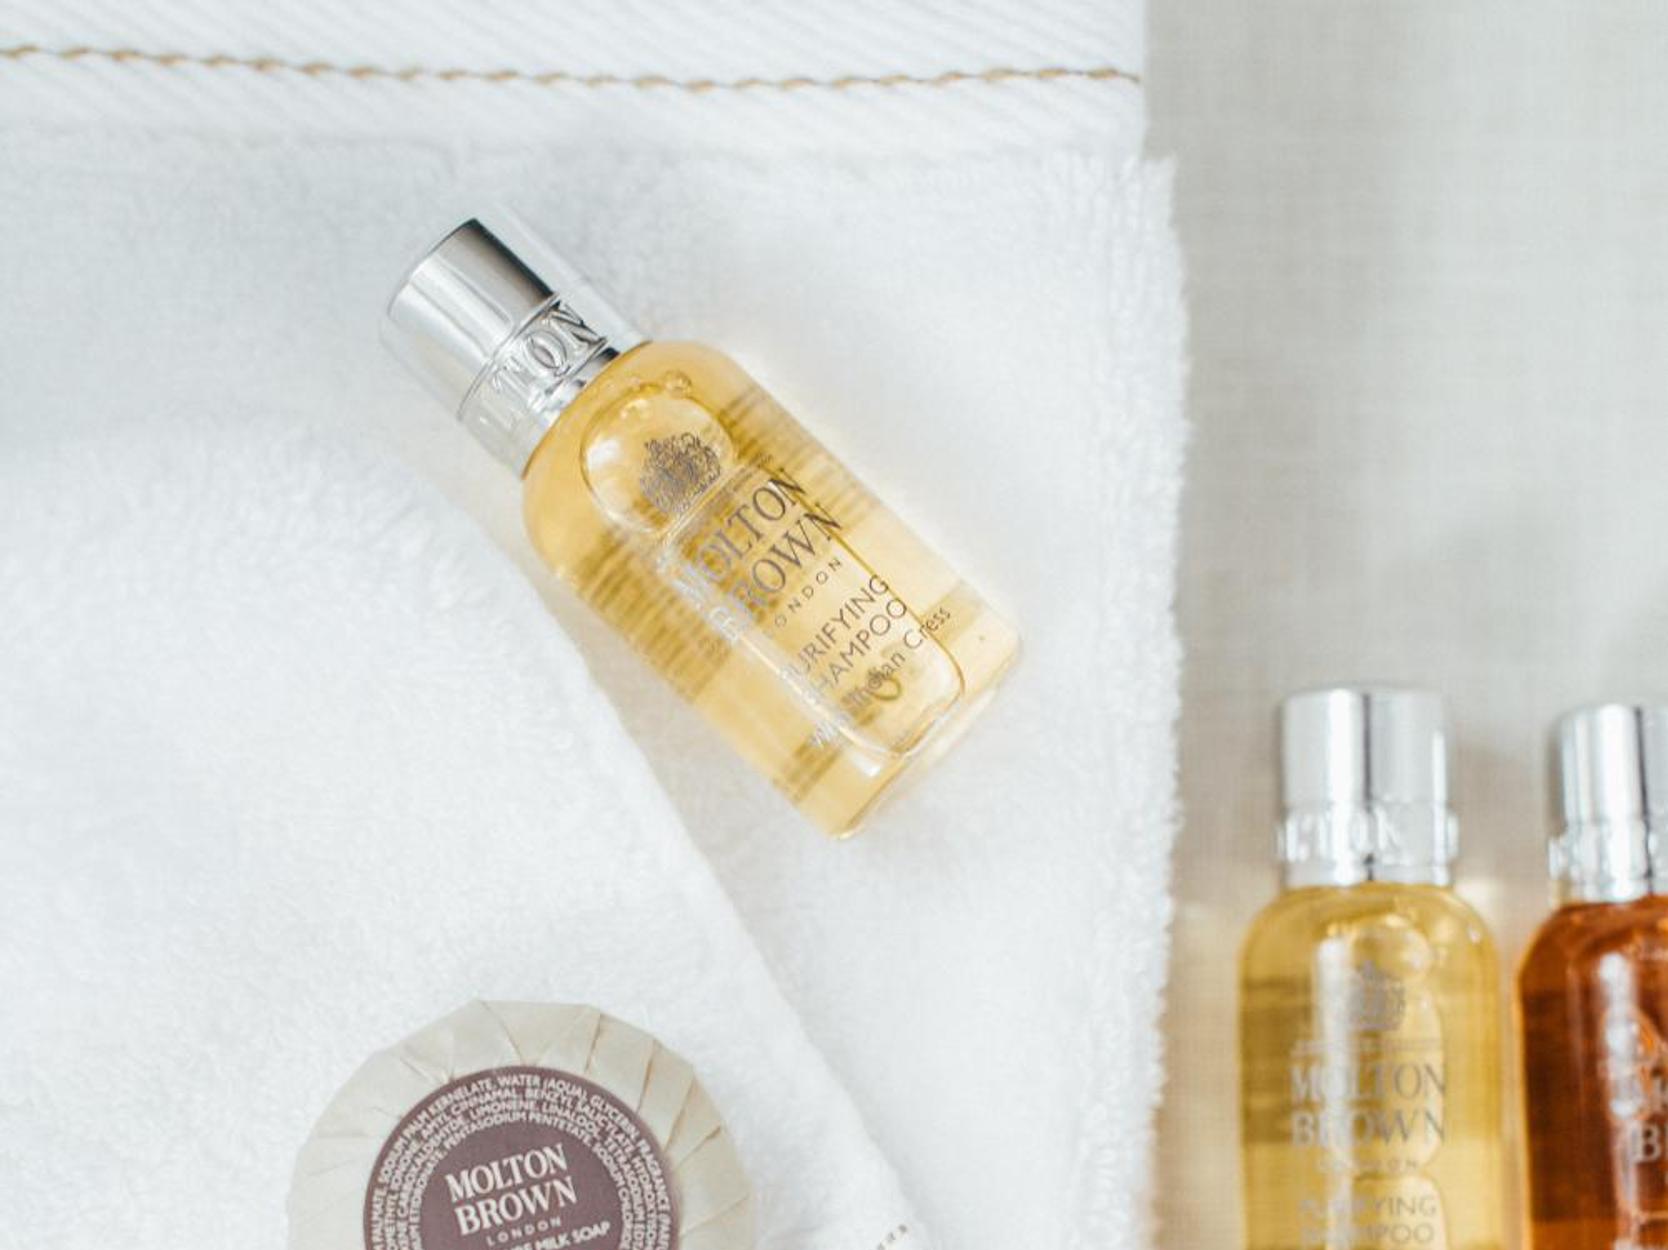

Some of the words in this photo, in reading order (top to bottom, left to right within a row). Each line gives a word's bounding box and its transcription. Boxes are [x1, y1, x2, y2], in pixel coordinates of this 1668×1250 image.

[764, 557, 843, 640] ONDON
[800, 597, 907, 702] HAMPOO
[903, 606, 951, 650] Cress
[524, 1087, 576, 1108] BENZYL
[401, 1110, 431, 1141] PALM
[495, 1074, 541, 1088] WATER
[633, 1137, 669, 1211] FRAGRANCE
[445, 1143, 568, 1203] MOLTON
[454, 1176, 578, 1236] BROWN
[1299, 1197, 1436, 1218] PFYING
[487, 1217, 561, 1247] LONDON
[571, 1221, 612, 1246] SOAP
[1300, 1224, 1435, 1244] MPOO
